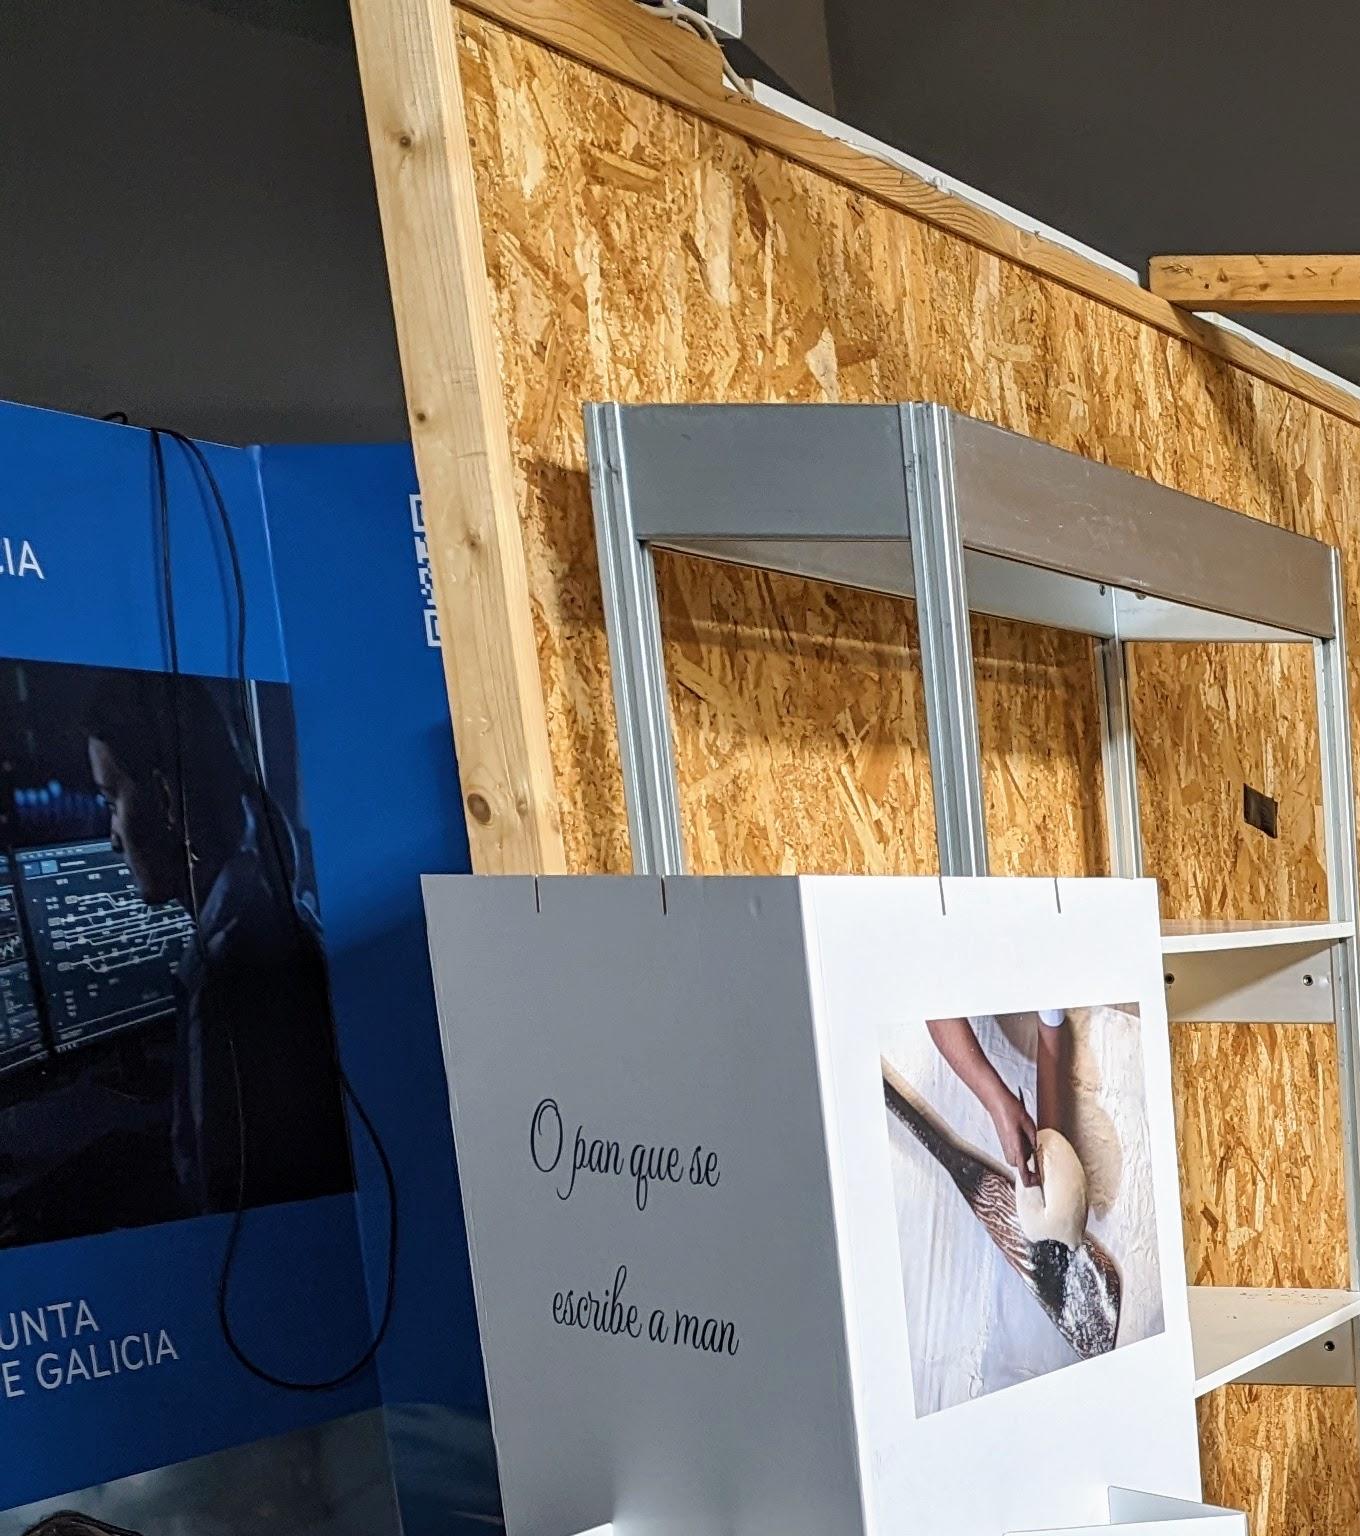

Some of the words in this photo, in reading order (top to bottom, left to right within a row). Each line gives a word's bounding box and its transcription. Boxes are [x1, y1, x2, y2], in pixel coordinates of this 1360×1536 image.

[530, 1098, 564, 1172] O
[557, 1124, 624, 1201] pan
[630, 1141, 684, 1211] que
[690, 1144, 720, 1188] se
[0, 1298, 99, 1351] UNTA
[552, 1265, 642, 1338] escribe
[648, 1309, 669, 1344] a
[674, 1310, 740, 1356] man
[35, 1329, 179, 1390] GALICIA
